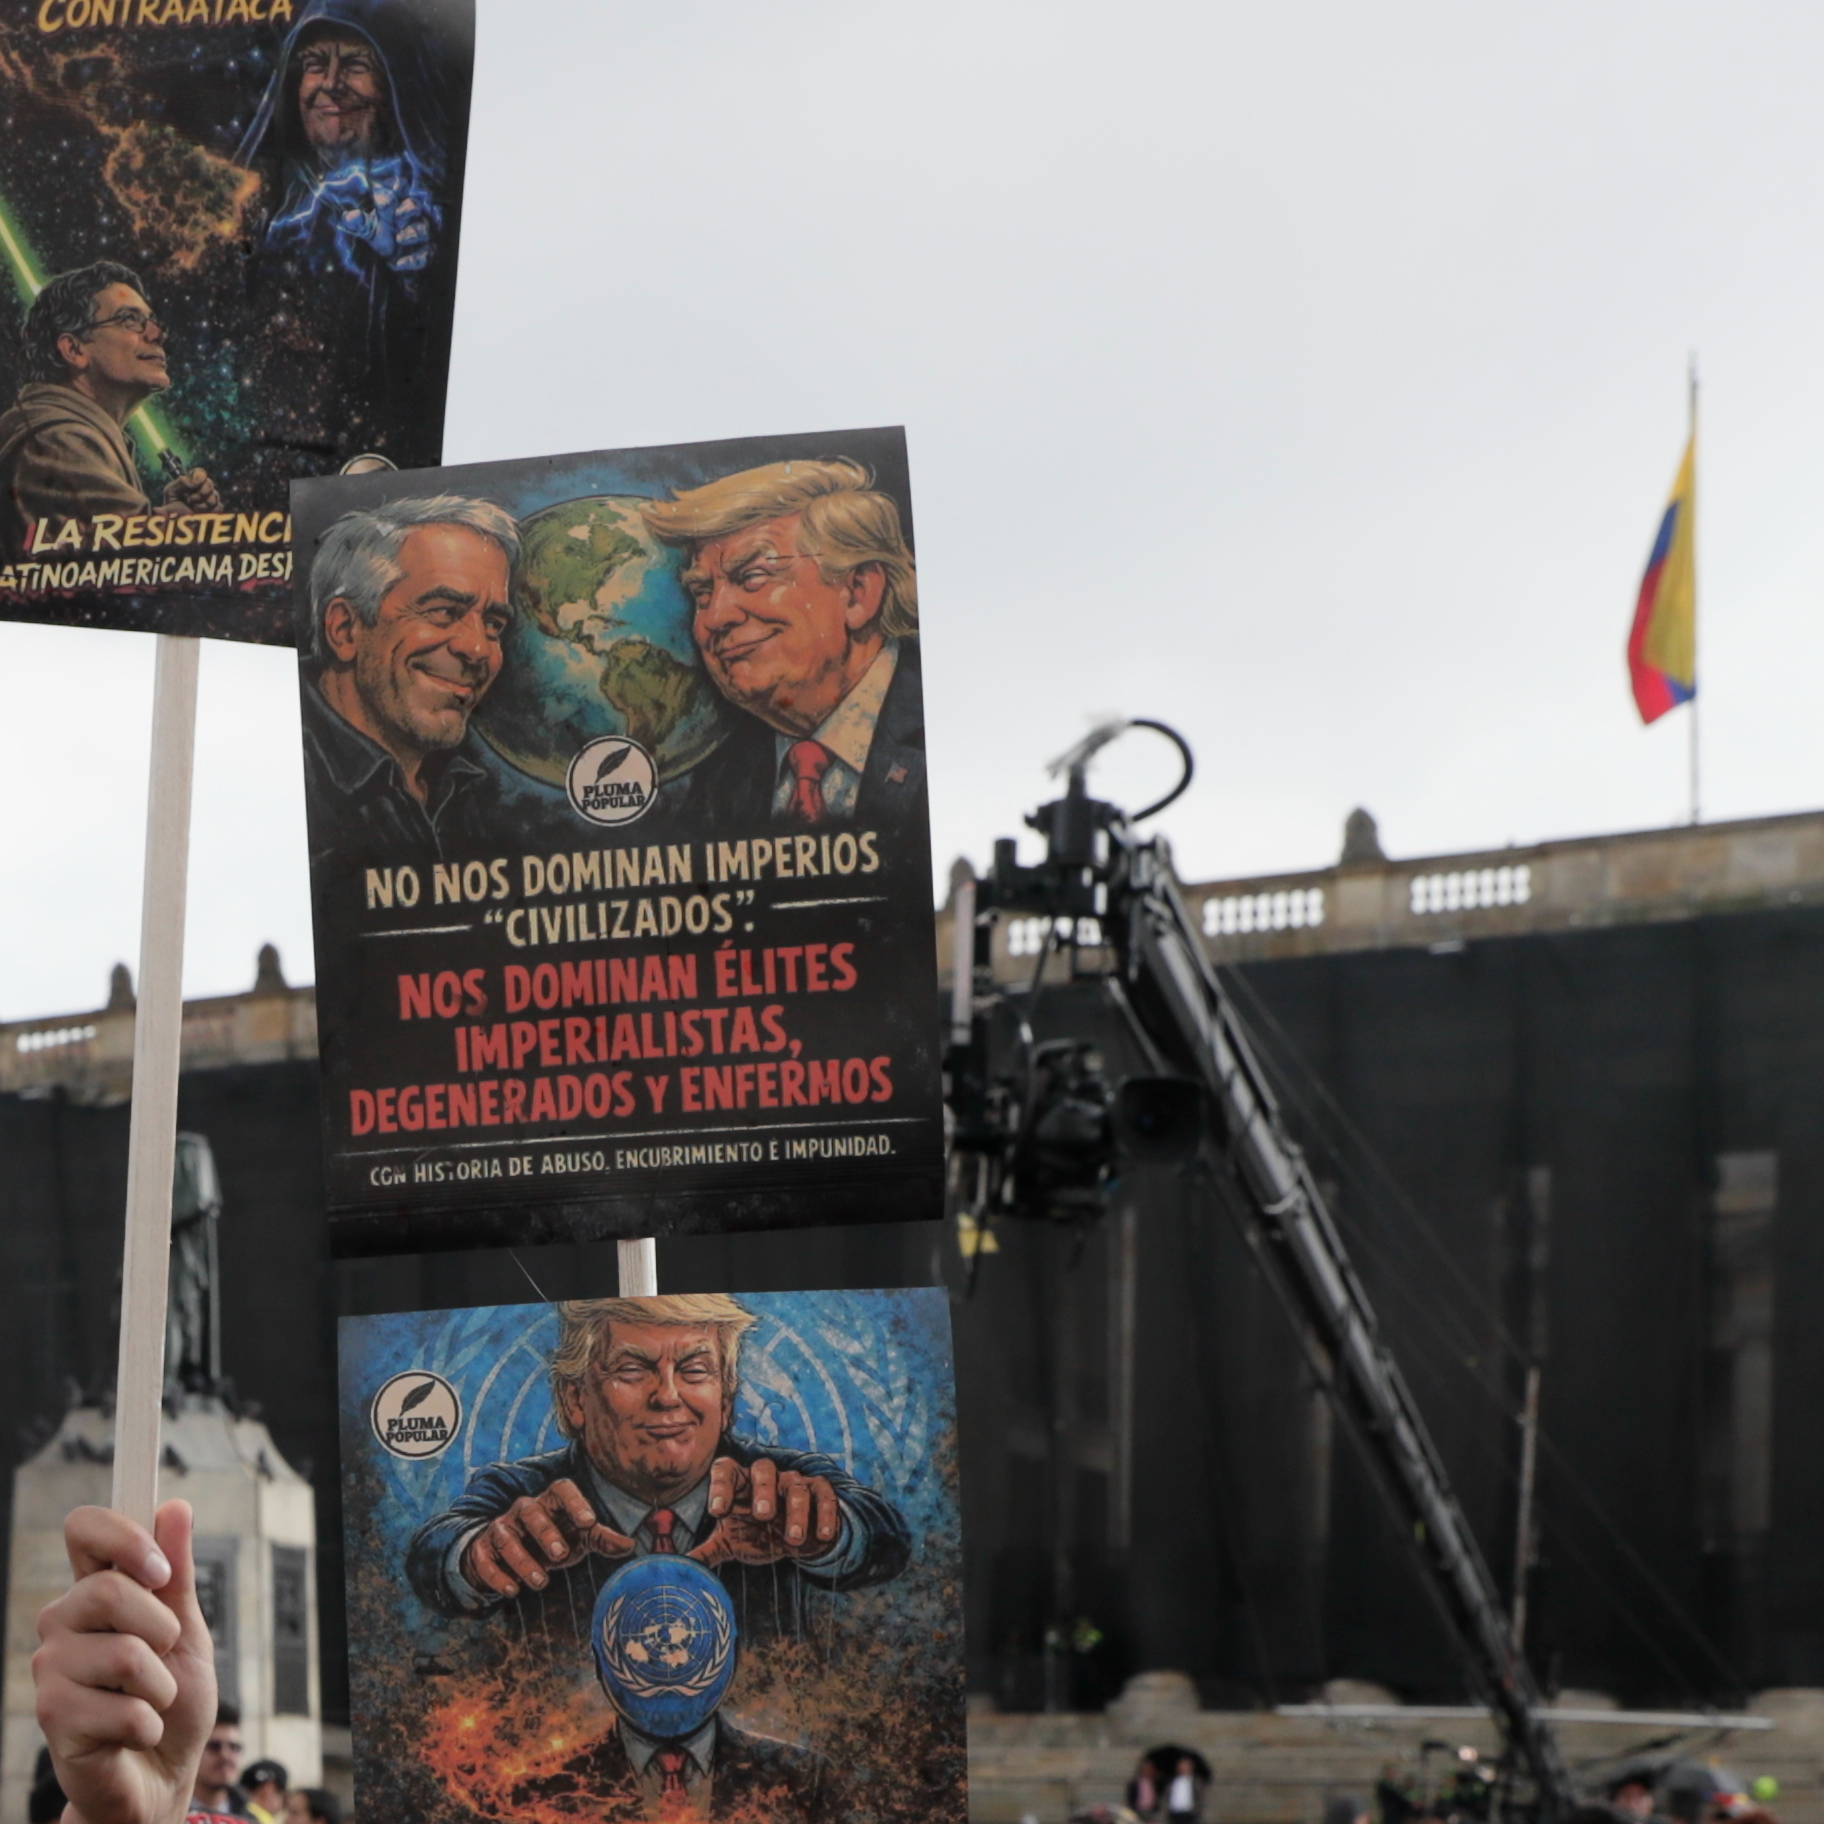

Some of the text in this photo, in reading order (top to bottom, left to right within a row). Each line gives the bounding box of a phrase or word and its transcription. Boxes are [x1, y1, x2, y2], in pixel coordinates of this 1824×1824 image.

[32, 517, 82, 554] LA
[582, 795, 646, 811] POPULAR
[583, 781, 644, 799] PLUMA
[365, 831, 880, 909] NO NOS DOMINAN IMPERIOS
[397, 940, 858, 1020] NOS DOMINAN ÉLITES
[454, 1005, 802, 1073] IMPERIALISTAS,
[349, 1056, 893, 1137] DEGENERADOS Y ENFERMOS
[414, 1157, 503, 1183] HISTORIA
[509, 1155, 534, 1177] DE
[616, 1142, 762, 1170] ENCUBRIMIENTO
[784, 1134, 896, 1160] IMPUNIDAD.
[385, 1429, 448, 1442] POPULAR
[387, 1415, 447, 1431] PLUMA
